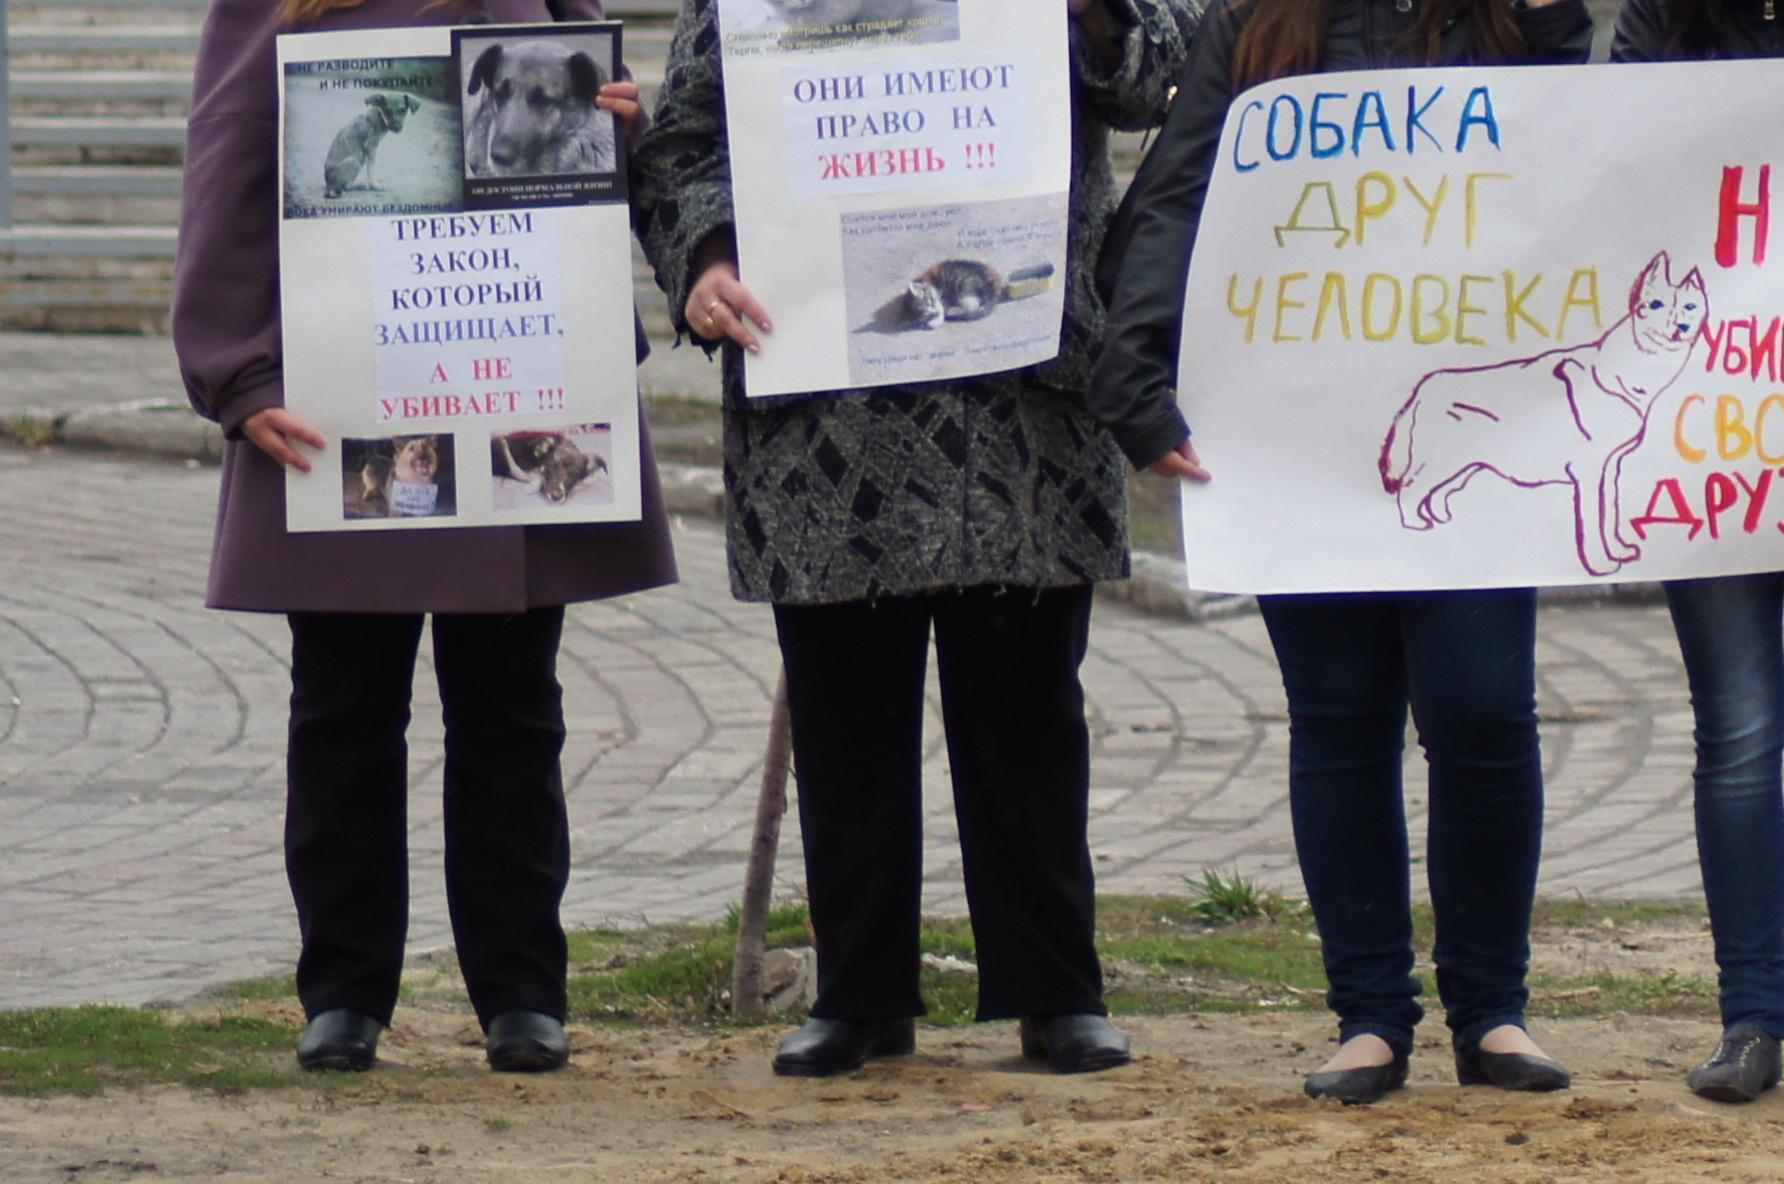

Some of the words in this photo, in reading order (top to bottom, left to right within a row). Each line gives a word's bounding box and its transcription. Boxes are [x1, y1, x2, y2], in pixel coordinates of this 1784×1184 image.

[317, 57, 393, 72] РАЗВОДИТЕ
[319, 79, 329, 90] И
[332, 79, 349, 89] НЕ
[793, 74, 865, 104] ОНИ
[884, 64, 1015, 98] ИМЕЮТ
[815, 108, 926, 141] ПРАВО
[952, 103, 998, 132] НА
[1234, 83, 1502, 173] СОБАКА
[817, 146, 946, 181] ЖИЗНЬ
[964, 142, 997, 171] !!!
[321, 203, 379, 217] УМИРАЮТ
[1273, 169, 1516, 248] ДРУГ
[391, 212, 535, 242] ТРЕБУЕМ
[410, 248, 520, 276] ЗАКОН,
[391, 274, 544, 311] КОТОРЫЙ
[1226, 264, 1603, 345] ЧЕЛОВЕКА
[374, 313, 565, 347] ЗАЩИЩАЕТ,
[429, 362, 450, 384] А
[472, 357, 513, 381] НЕ
[379, 390, 521, 421] УБИВАЕТ
[537, 387, 566, 411] !!!
